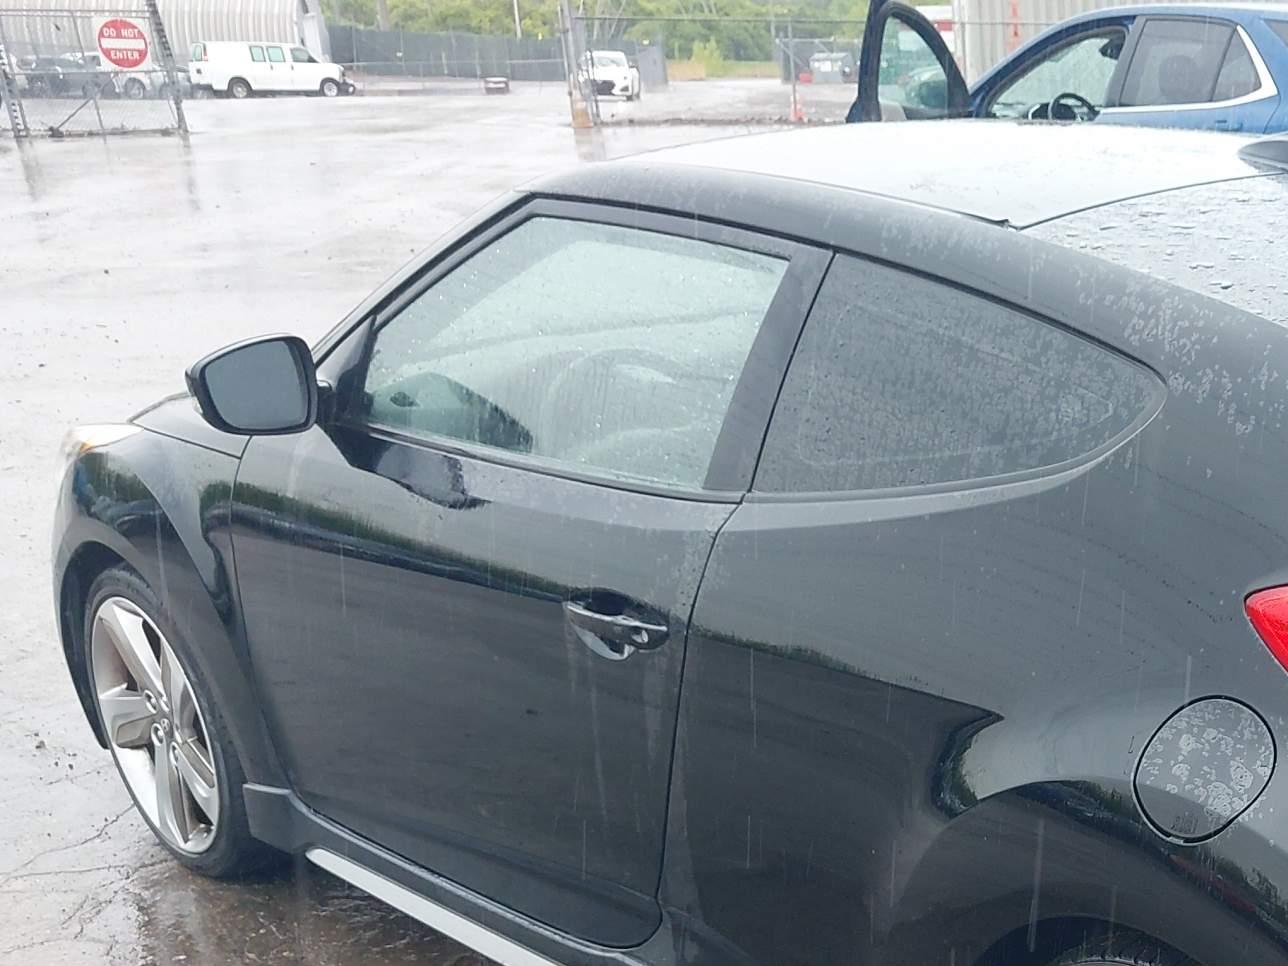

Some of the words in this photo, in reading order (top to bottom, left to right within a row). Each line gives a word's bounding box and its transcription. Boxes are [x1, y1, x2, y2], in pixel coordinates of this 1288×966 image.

[102, 27, 117, 38] DO
[120, 28, 139, 39] NOT
[110, 50, 140, 60] ENTER
